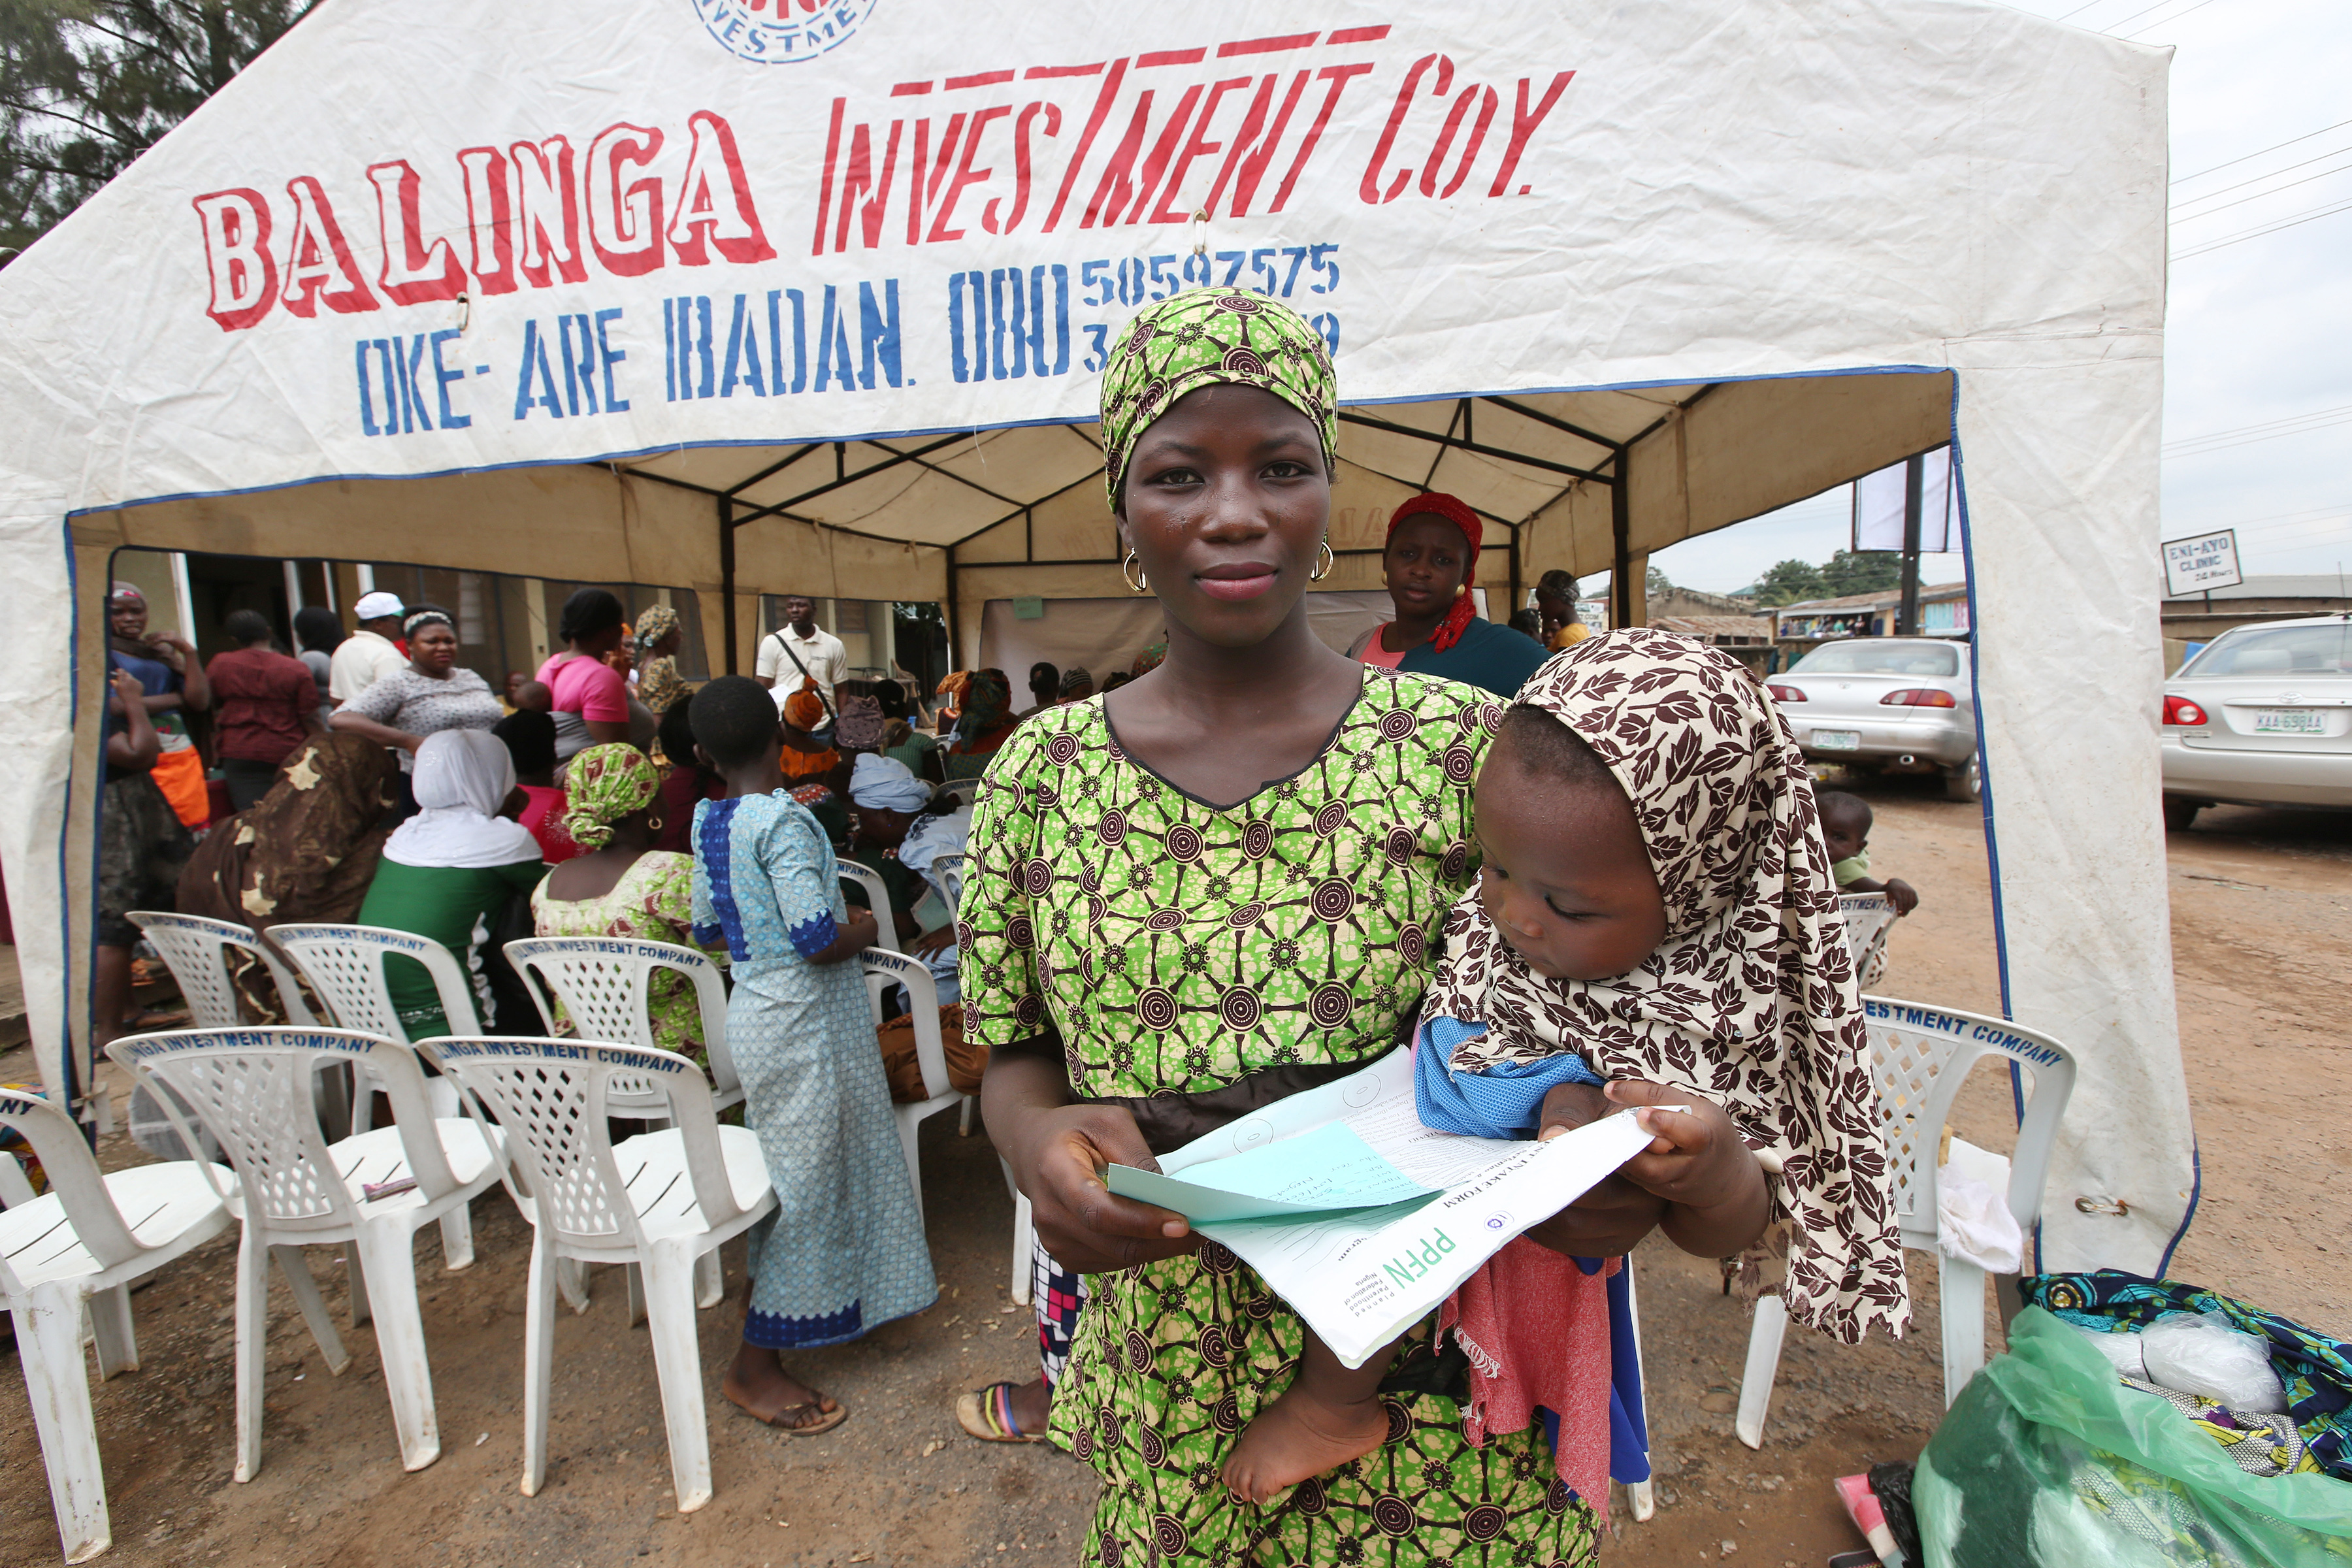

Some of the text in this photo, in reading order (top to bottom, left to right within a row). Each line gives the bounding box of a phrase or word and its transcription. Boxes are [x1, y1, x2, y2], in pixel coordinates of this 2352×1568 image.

[191, 52, 1577, 333] BALINGA INVESTMENT COY.
[514, 307, 630, 420] ARE
[662, 278, 915, 402] IBADAN.
[2169, 538, 2229, 560] ENI-AYO
[2180, 555, 2222, 572] CLINIC
[362, 932, 427, 951] COMPANY
[556, 941, 633, 955] INVESTMENT
[638, 946, 705, 967] COMPANY
[167, 1032, 274, 1051] INVESTMENT
[281, 1033, 378, 1054] COMPANY
[1864, 1000, 2064, 1068] ESTMENT COMPANY
[485, 1041, 589, 1060] INVESTMENT
[597, 1049, 686, 1074] COMPANY
[1482, 1158, 1528, 1188] INTAKE
[1442, 1186, 1482, 1209] FORM
[1381, 1224, 1458, 1291] PPFN
[1350, 1277, 1383, 1301] Federation
[1354, 1270, 1377, 1288] Nigeria
[1348, 1284, 1388, 1312] Parenthood
[1354, 1290, 1395, 1318] Planned
